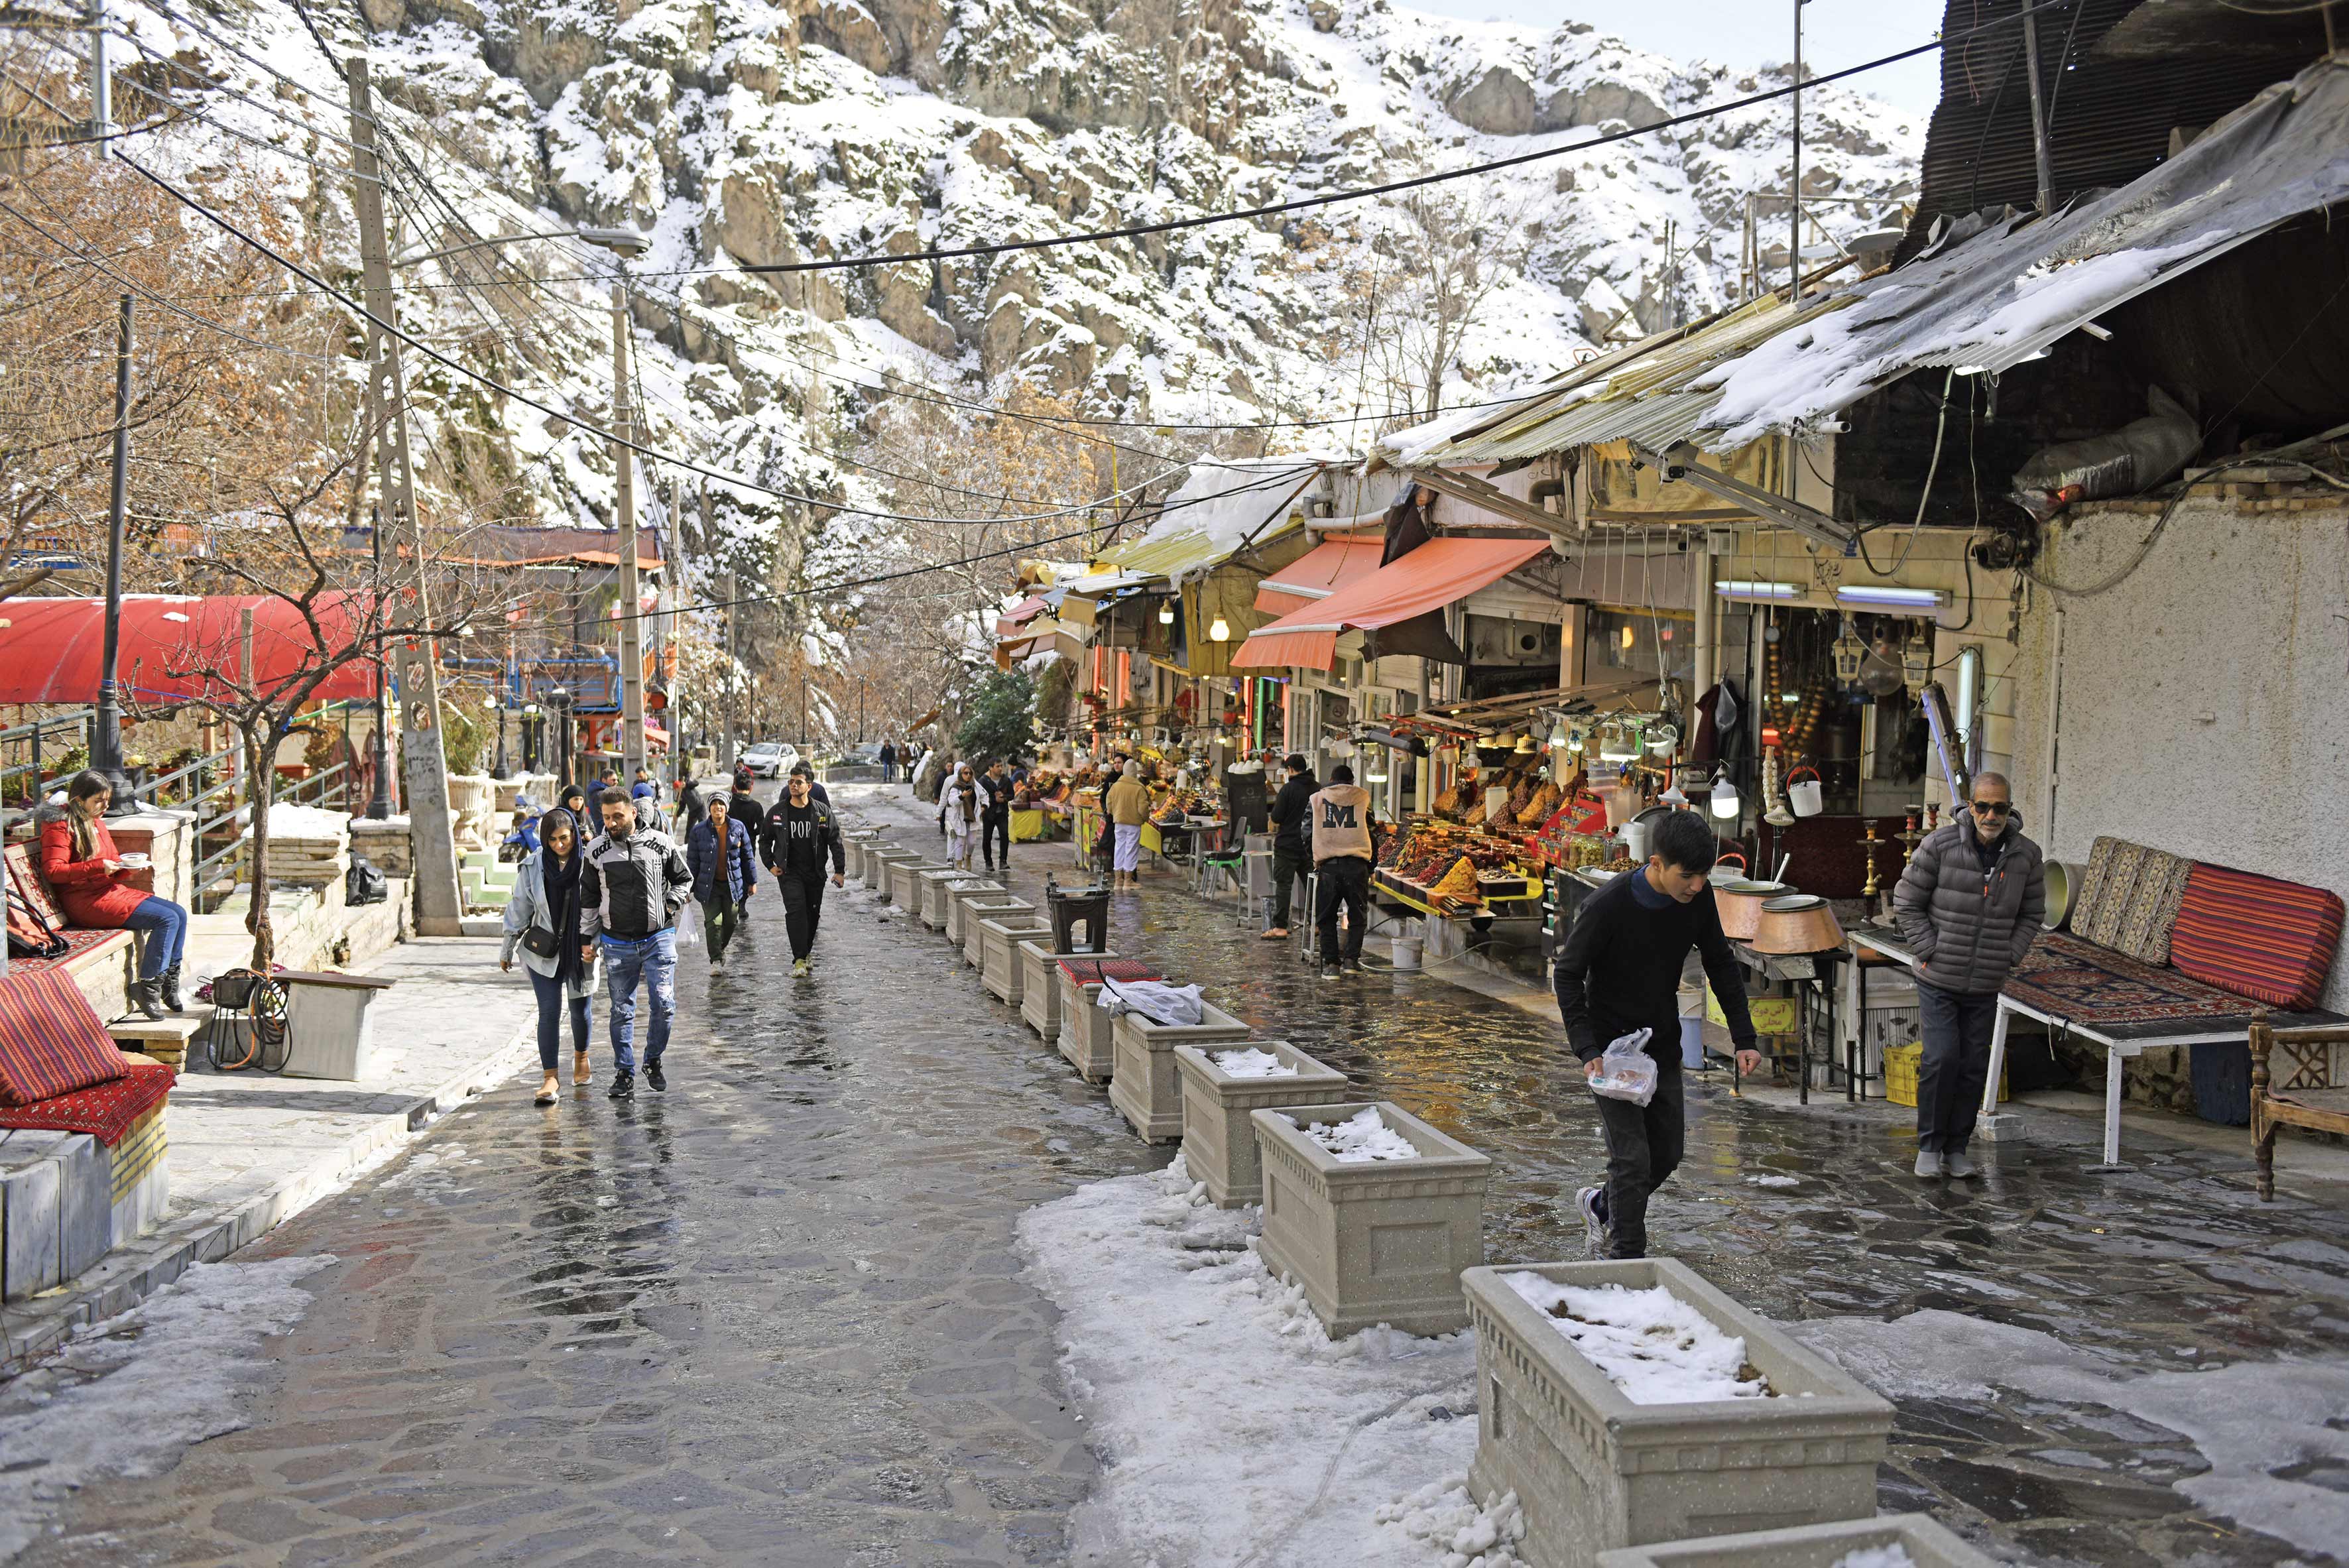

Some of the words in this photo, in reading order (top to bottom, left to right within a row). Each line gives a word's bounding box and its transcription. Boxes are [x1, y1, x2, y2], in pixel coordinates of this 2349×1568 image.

[1322, 798, 1358, 828] M
[592, 837, 612, 859] adi
[643, 837, 665, 855] das
